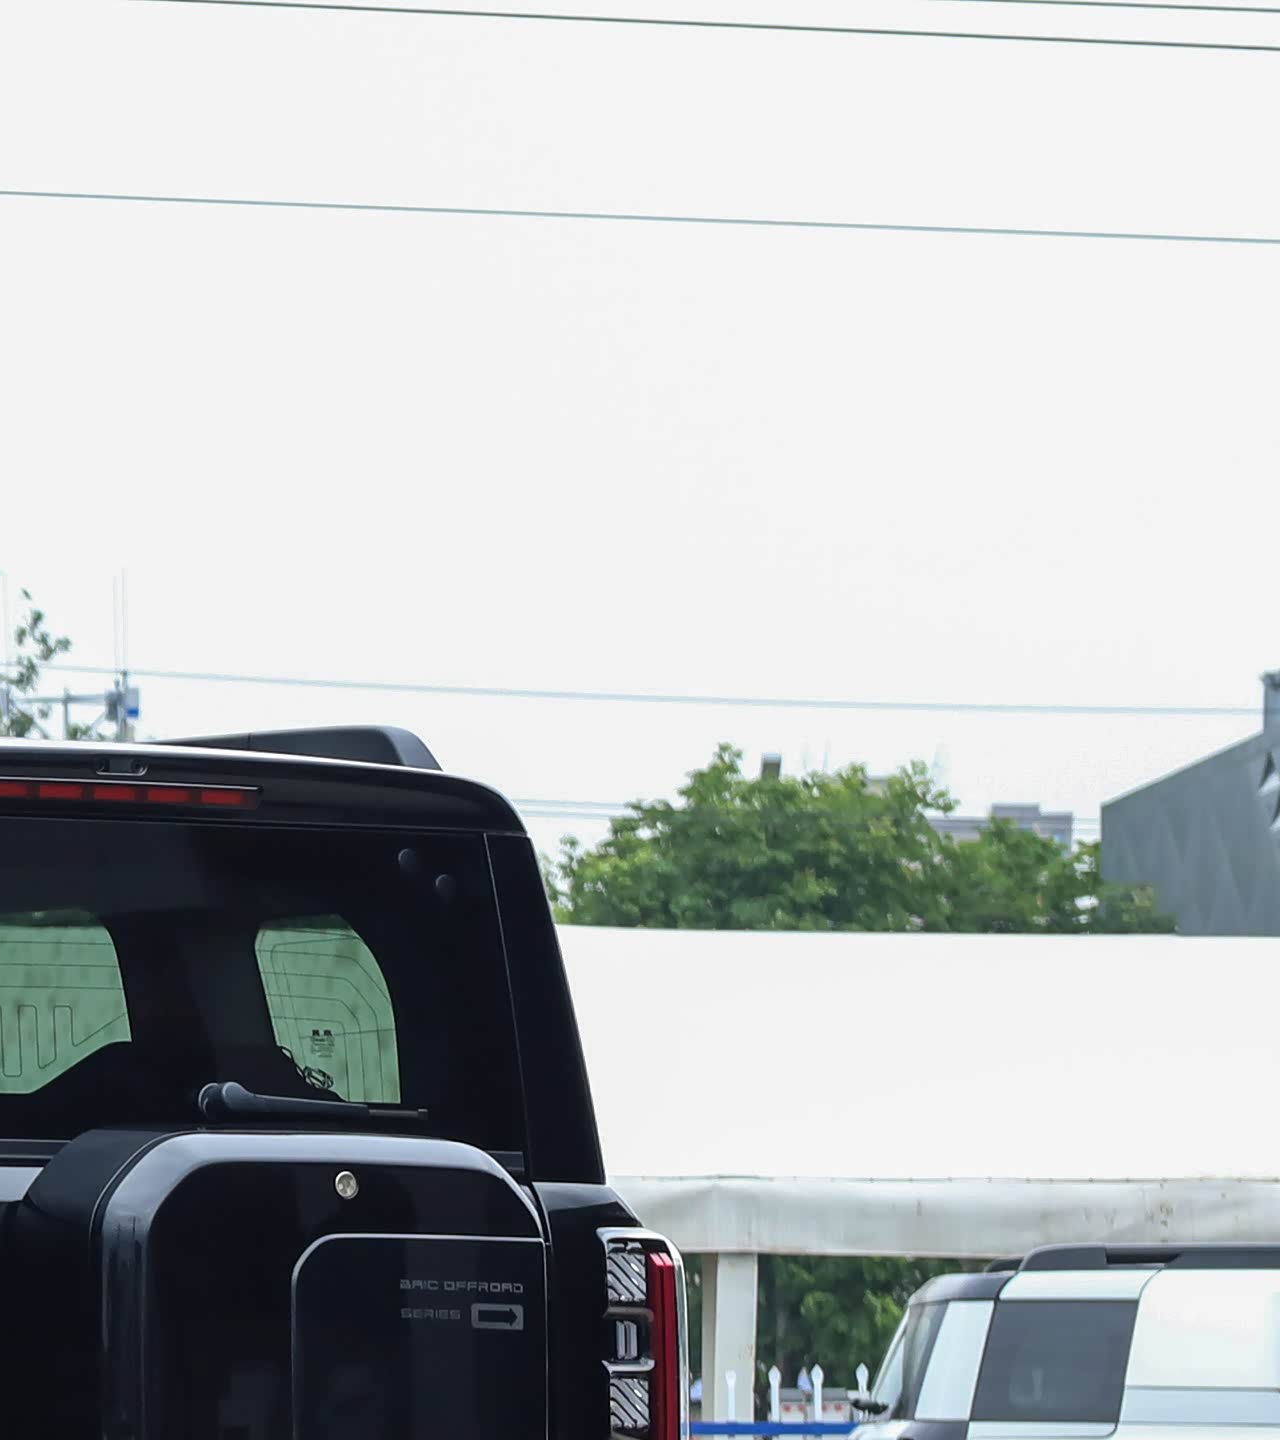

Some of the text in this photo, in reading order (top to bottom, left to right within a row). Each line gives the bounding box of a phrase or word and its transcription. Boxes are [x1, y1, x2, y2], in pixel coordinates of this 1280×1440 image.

[400, 1279, 523, 1293] BAIC OFFROAD
[400, 1308, 461, 1320] SERIES
